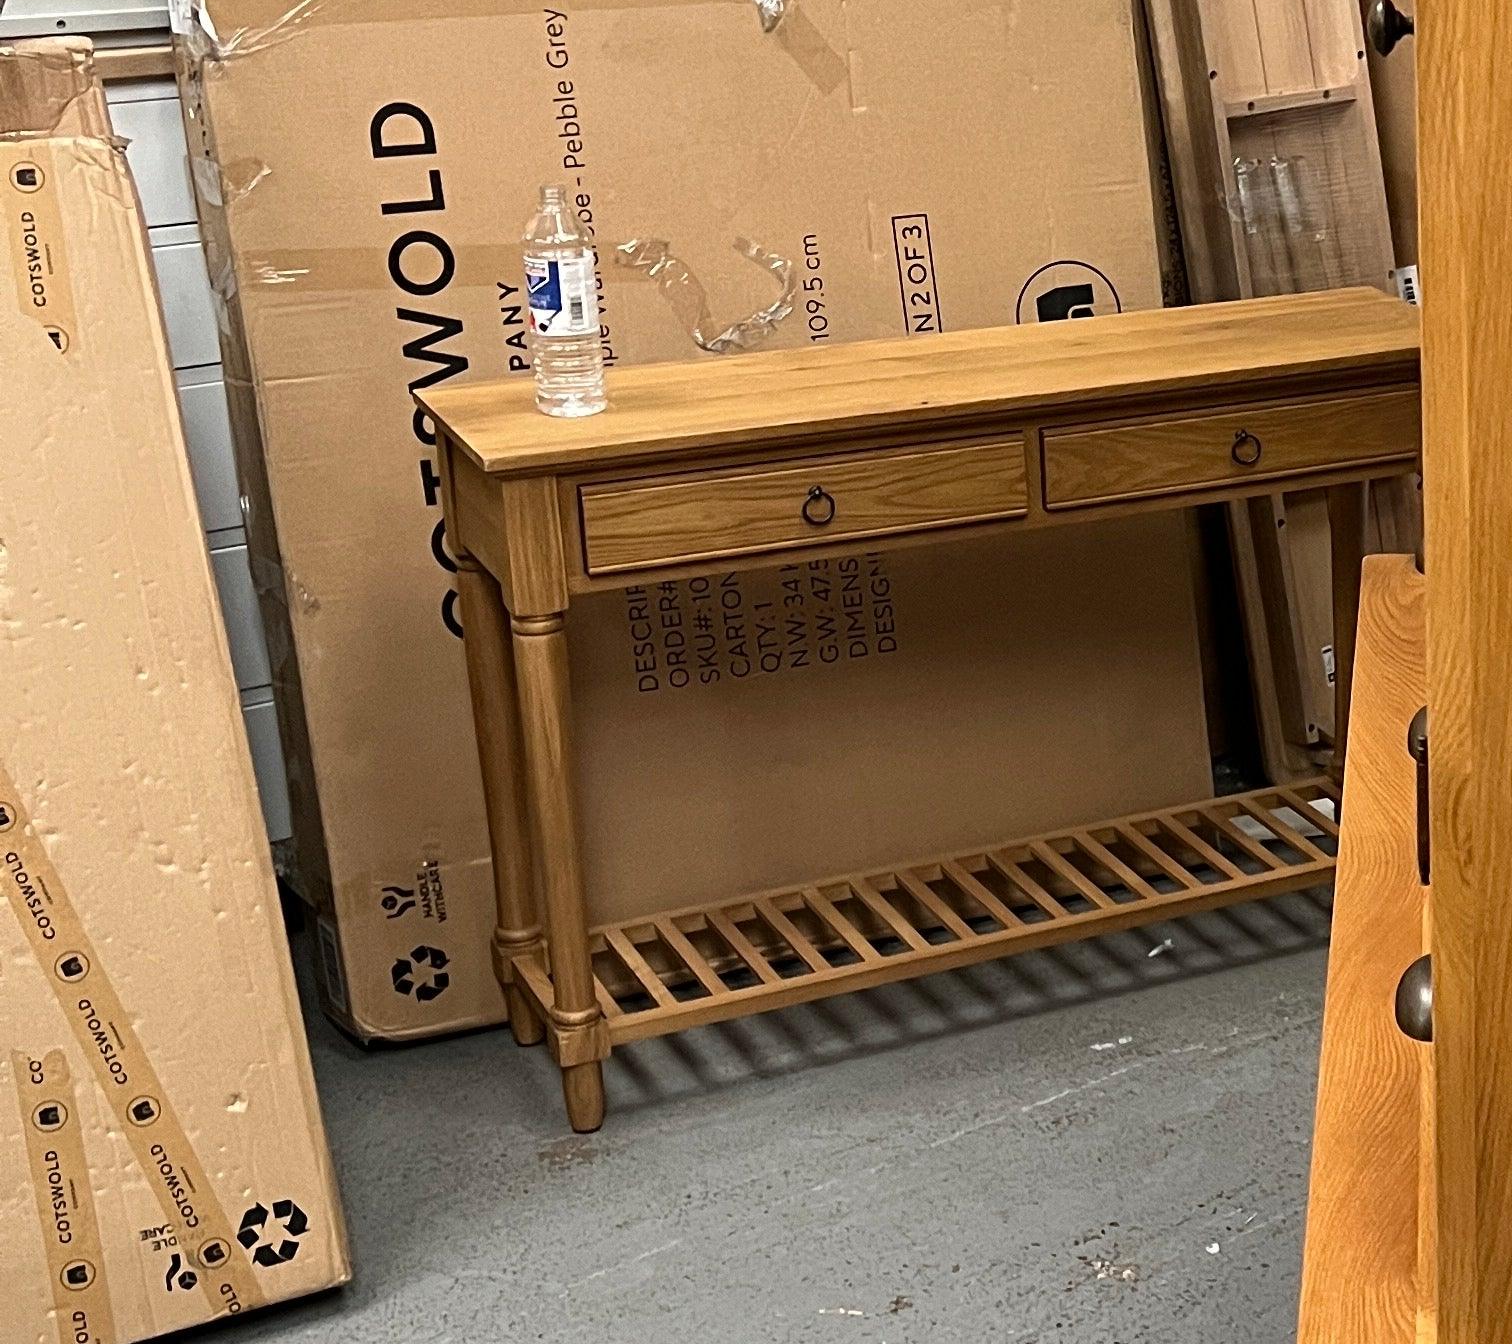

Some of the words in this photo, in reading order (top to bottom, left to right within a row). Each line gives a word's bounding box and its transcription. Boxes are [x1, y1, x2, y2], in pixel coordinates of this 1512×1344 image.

[544, 8, 568, 68] Grey
[553, 80, 586, 169] Pebble
[21, 211, 46, 307] COTSWOLD
[803, 234, 820, 270] cm
[901, 225, 922, 239] 3
[904, 246, 927, 285] OF
[803, 277, 829, 342] 109.5
[911, 291, 931, 306] 2
[5, 852, 56, 940] COTSWOLD
[416, 872, 435, 918] HANDLE
[78, 999, 128, 1085] COTSWOLD
[45, 1150, 72, 1244] COTSWOLD
[150, 1144, 199, 1229] COTSWOLD
